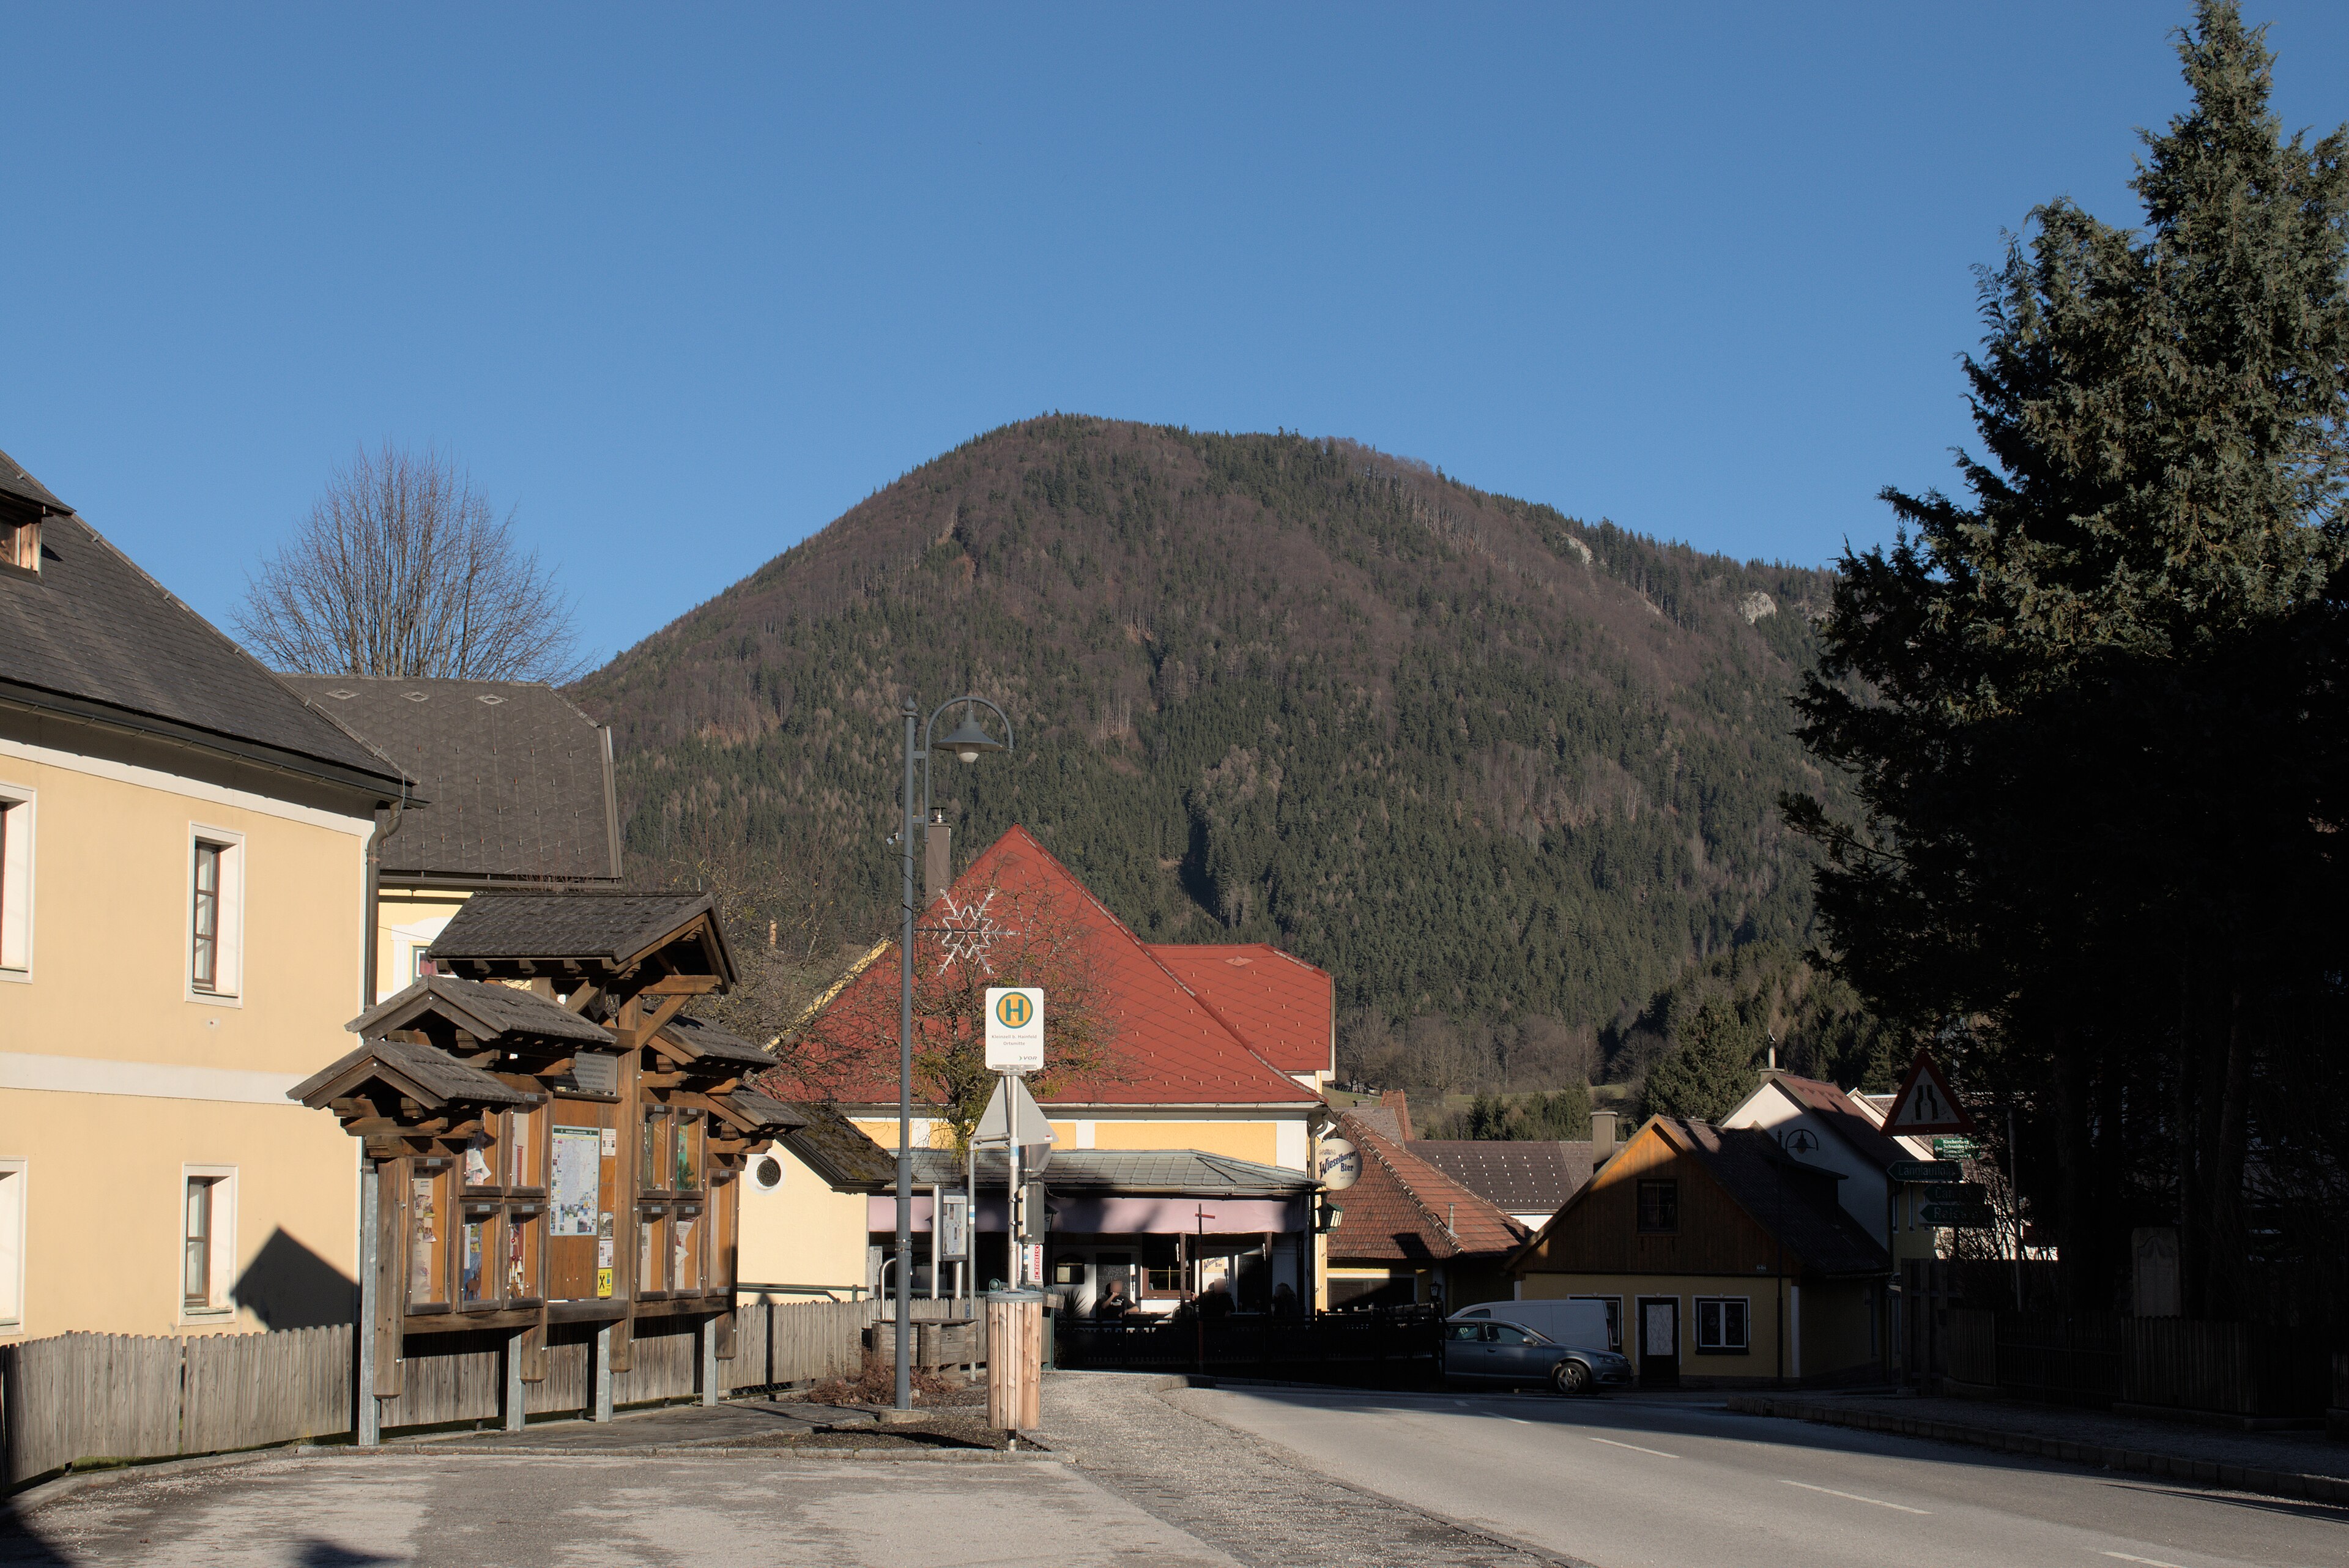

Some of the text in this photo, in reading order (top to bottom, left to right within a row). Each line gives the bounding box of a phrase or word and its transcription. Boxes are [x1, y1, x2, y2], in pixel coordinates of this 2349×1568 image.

[1006, 999, 1023, 1021] H
[1319, 1151, 1356, 1180] Wieselburger
[1340, 1163, 1354, 1172] Bier
